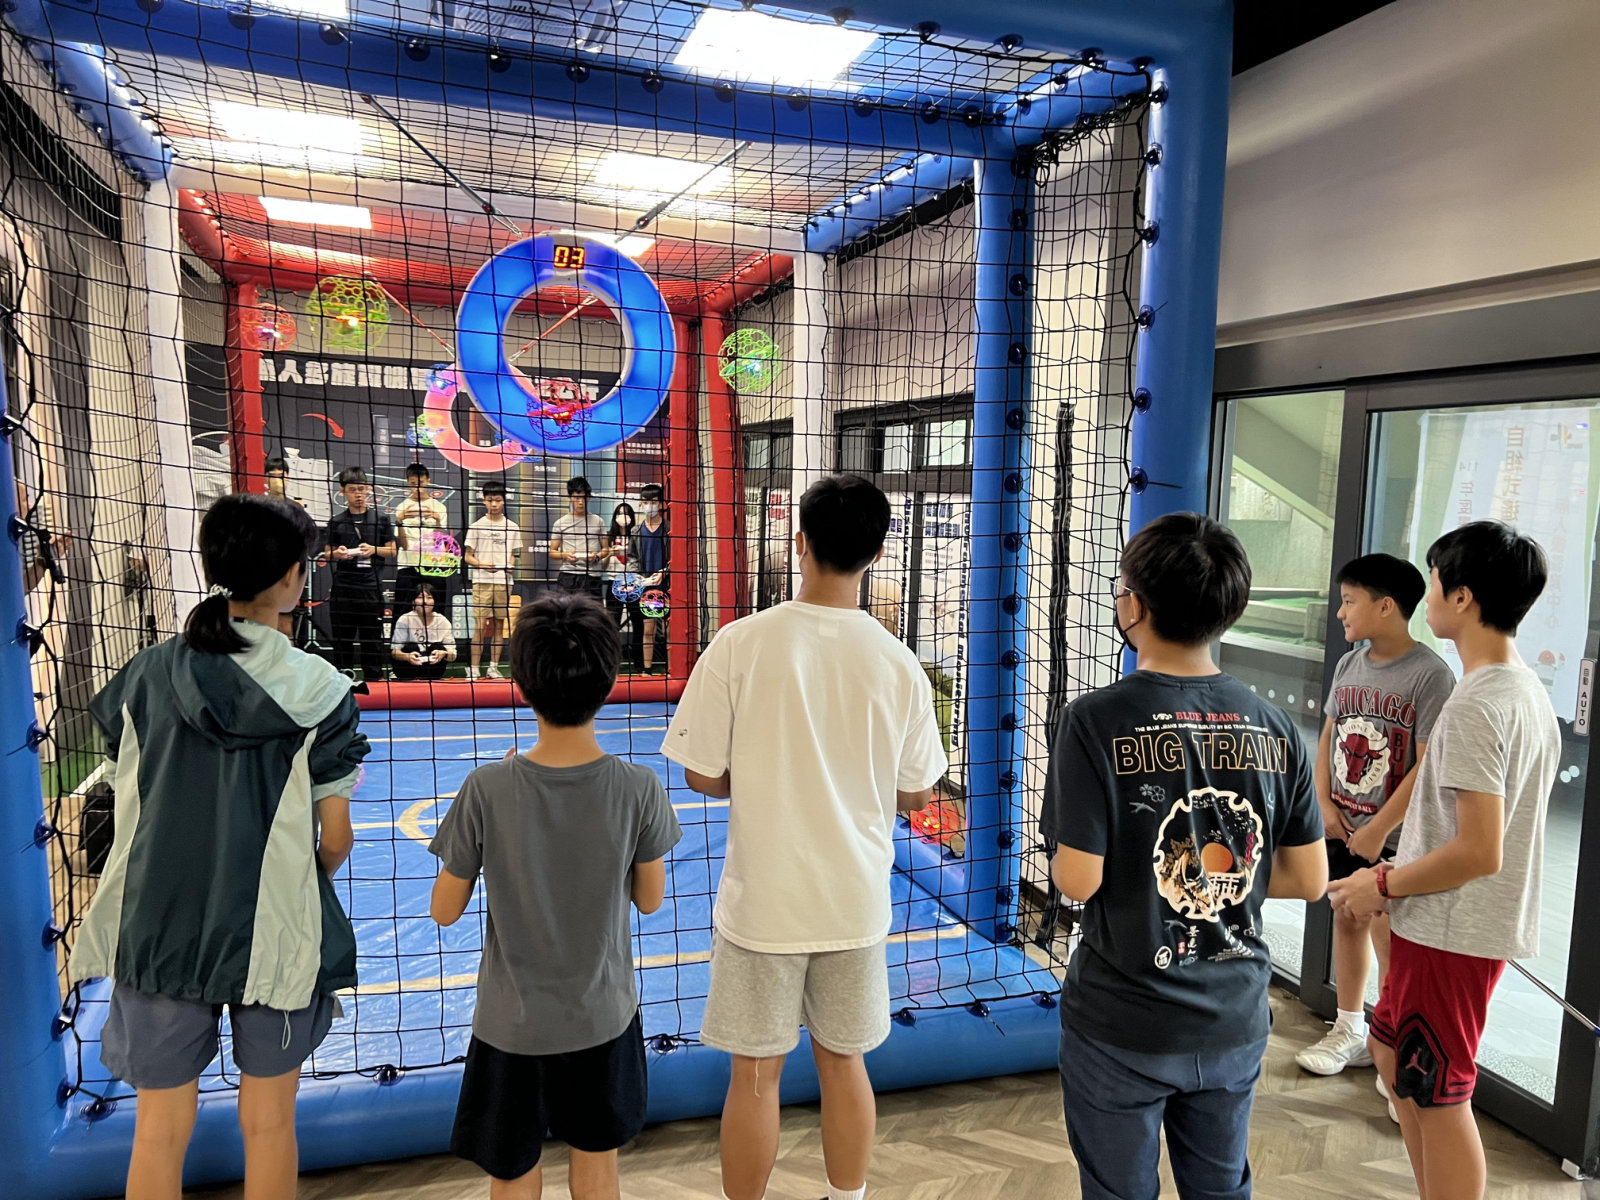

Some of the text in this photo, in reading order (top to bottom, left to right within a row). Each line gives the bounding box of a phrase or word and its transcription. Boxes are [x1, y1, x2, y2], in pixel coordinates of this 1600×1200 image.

[554, 246, 584, 268] 03
[1175, 711, 1241, 722] BLUE JEANS
[1578, 691, 1588, 726] AUTO
[1113, 731, 1185, 775] BIG
[1192, 732, 1288, 774] TRAIN
